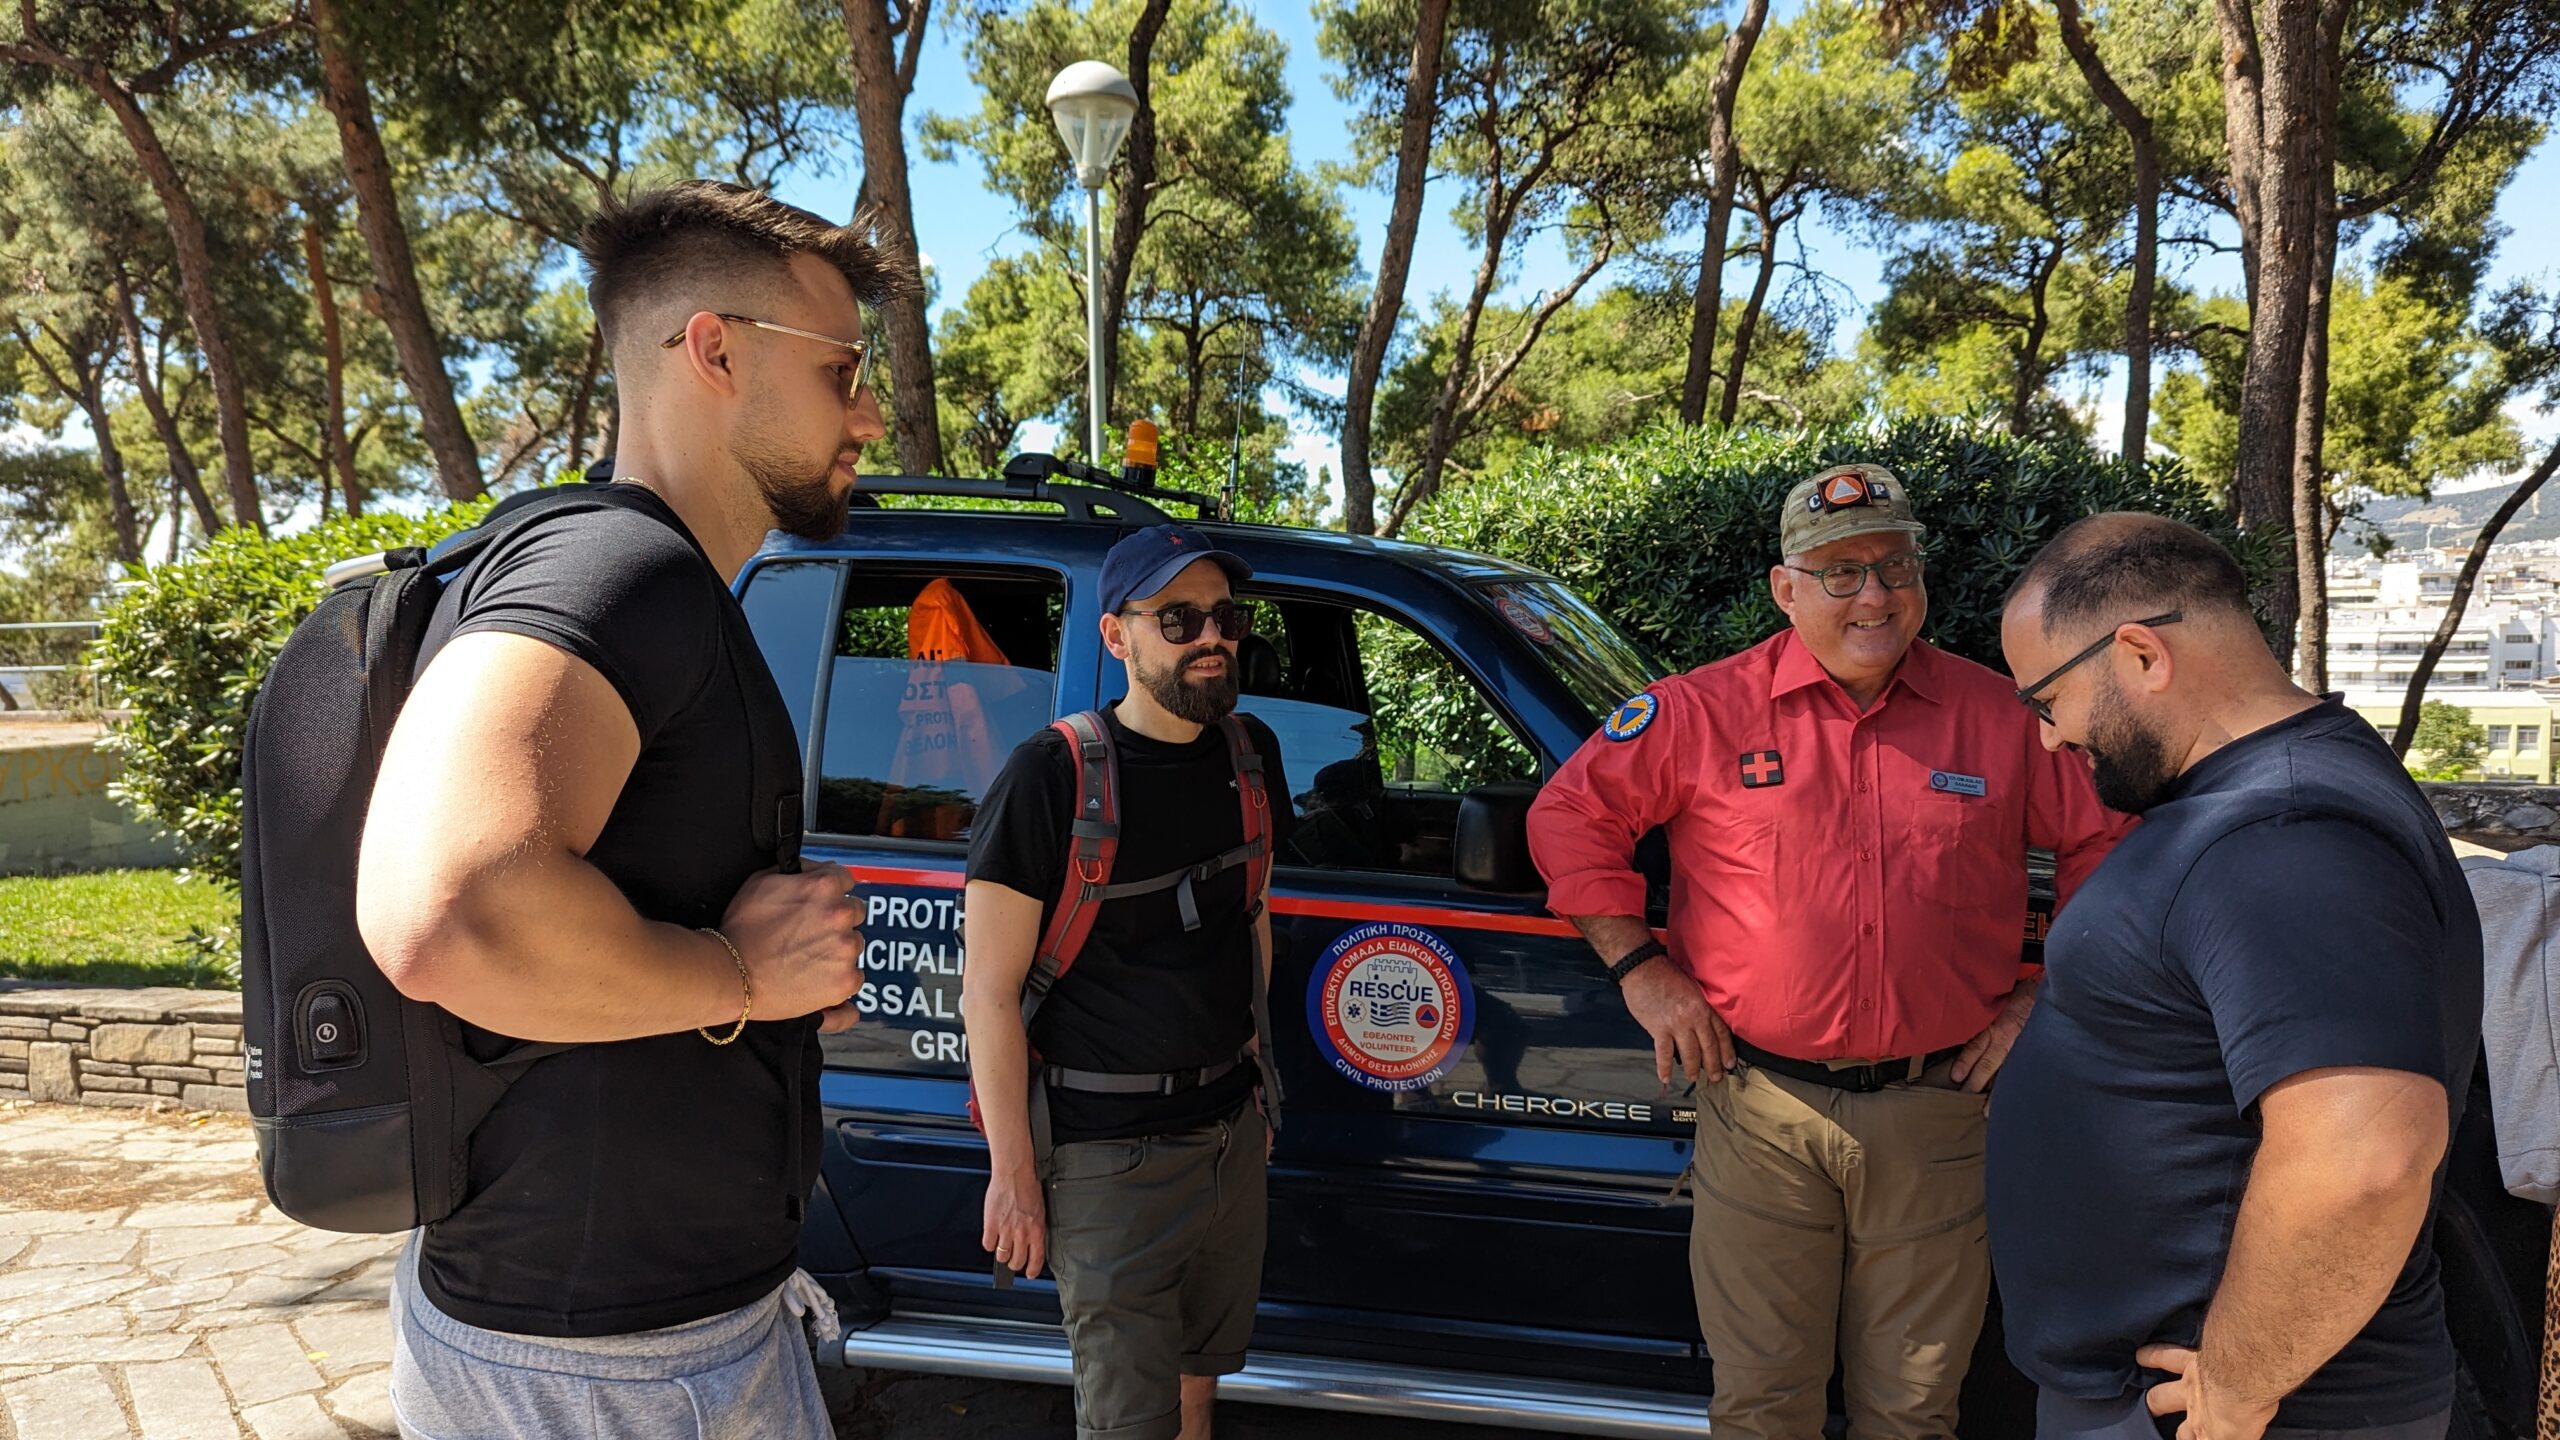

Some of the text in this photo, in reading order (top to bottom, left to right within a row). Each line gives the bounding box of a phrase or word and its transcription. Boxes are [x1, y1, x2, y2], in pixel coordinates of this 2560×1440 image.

[1808, 495, 1821, 508] C
[1873, 484, 1885, 496] P
[1332, 924, 1454, 966] ΠΟΛΙΤΙΚΗ ΠΡΟΣΤΑΣΙΑ
[856, 982, 965, 1019] SSAL
[1326, 940, 1456, 1041] ΕΠΙΛΕΚΤΗ ΟΜΑΔΑ ΕΙΔΙΚΩΝ ΑΠΟΣΤΟΛΩΝ
[1350, 980, 1433, 1003] RESCUE
[1360, 1041, 1418, 1054] VOLUNTEERS
[1362, 1031, 1416, 1043] ΕΘΕΛΟΝΤΕΣ
[1338, 1037, 1439, 1074] ΔΗΜΟΥ ΘΕΣΣΑΛΟΝΙΚΗΣ
[1335, 1058, 1443, 1091] CIVIL PROTECTION
[1452, 1091, 1652, 1122] CHEROKEE
